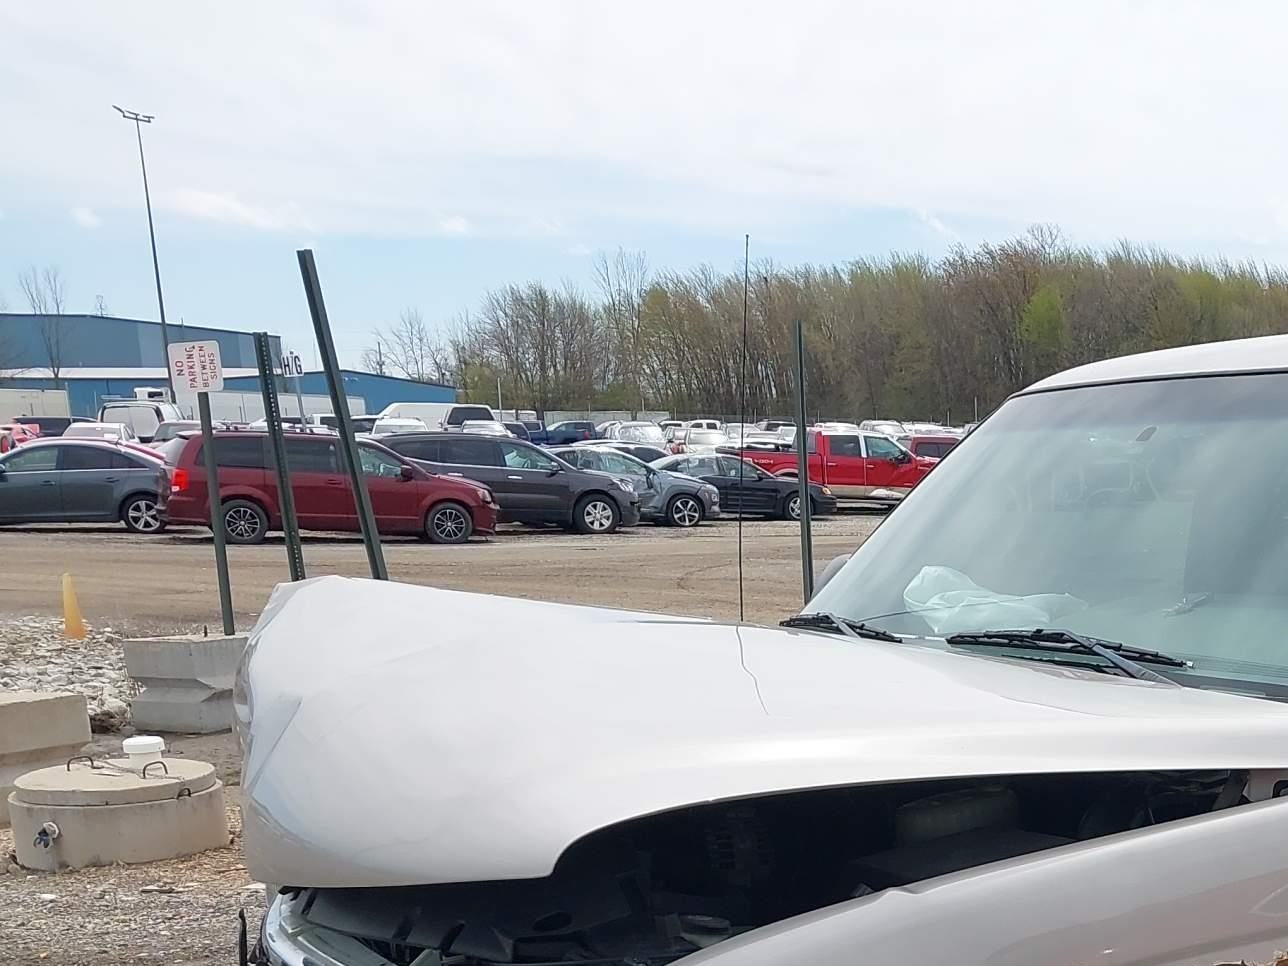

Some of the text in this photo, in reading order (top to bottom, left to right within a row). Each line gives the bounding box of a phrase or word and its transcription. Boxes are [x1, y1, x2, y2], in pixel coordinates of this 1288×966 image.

[175, 360, 185, 376] NO
[185, 345, 198, 389] PARKING
[198, 345, 210, 388] BETWEEN
[208, 352, 218, 380] SIGNS
